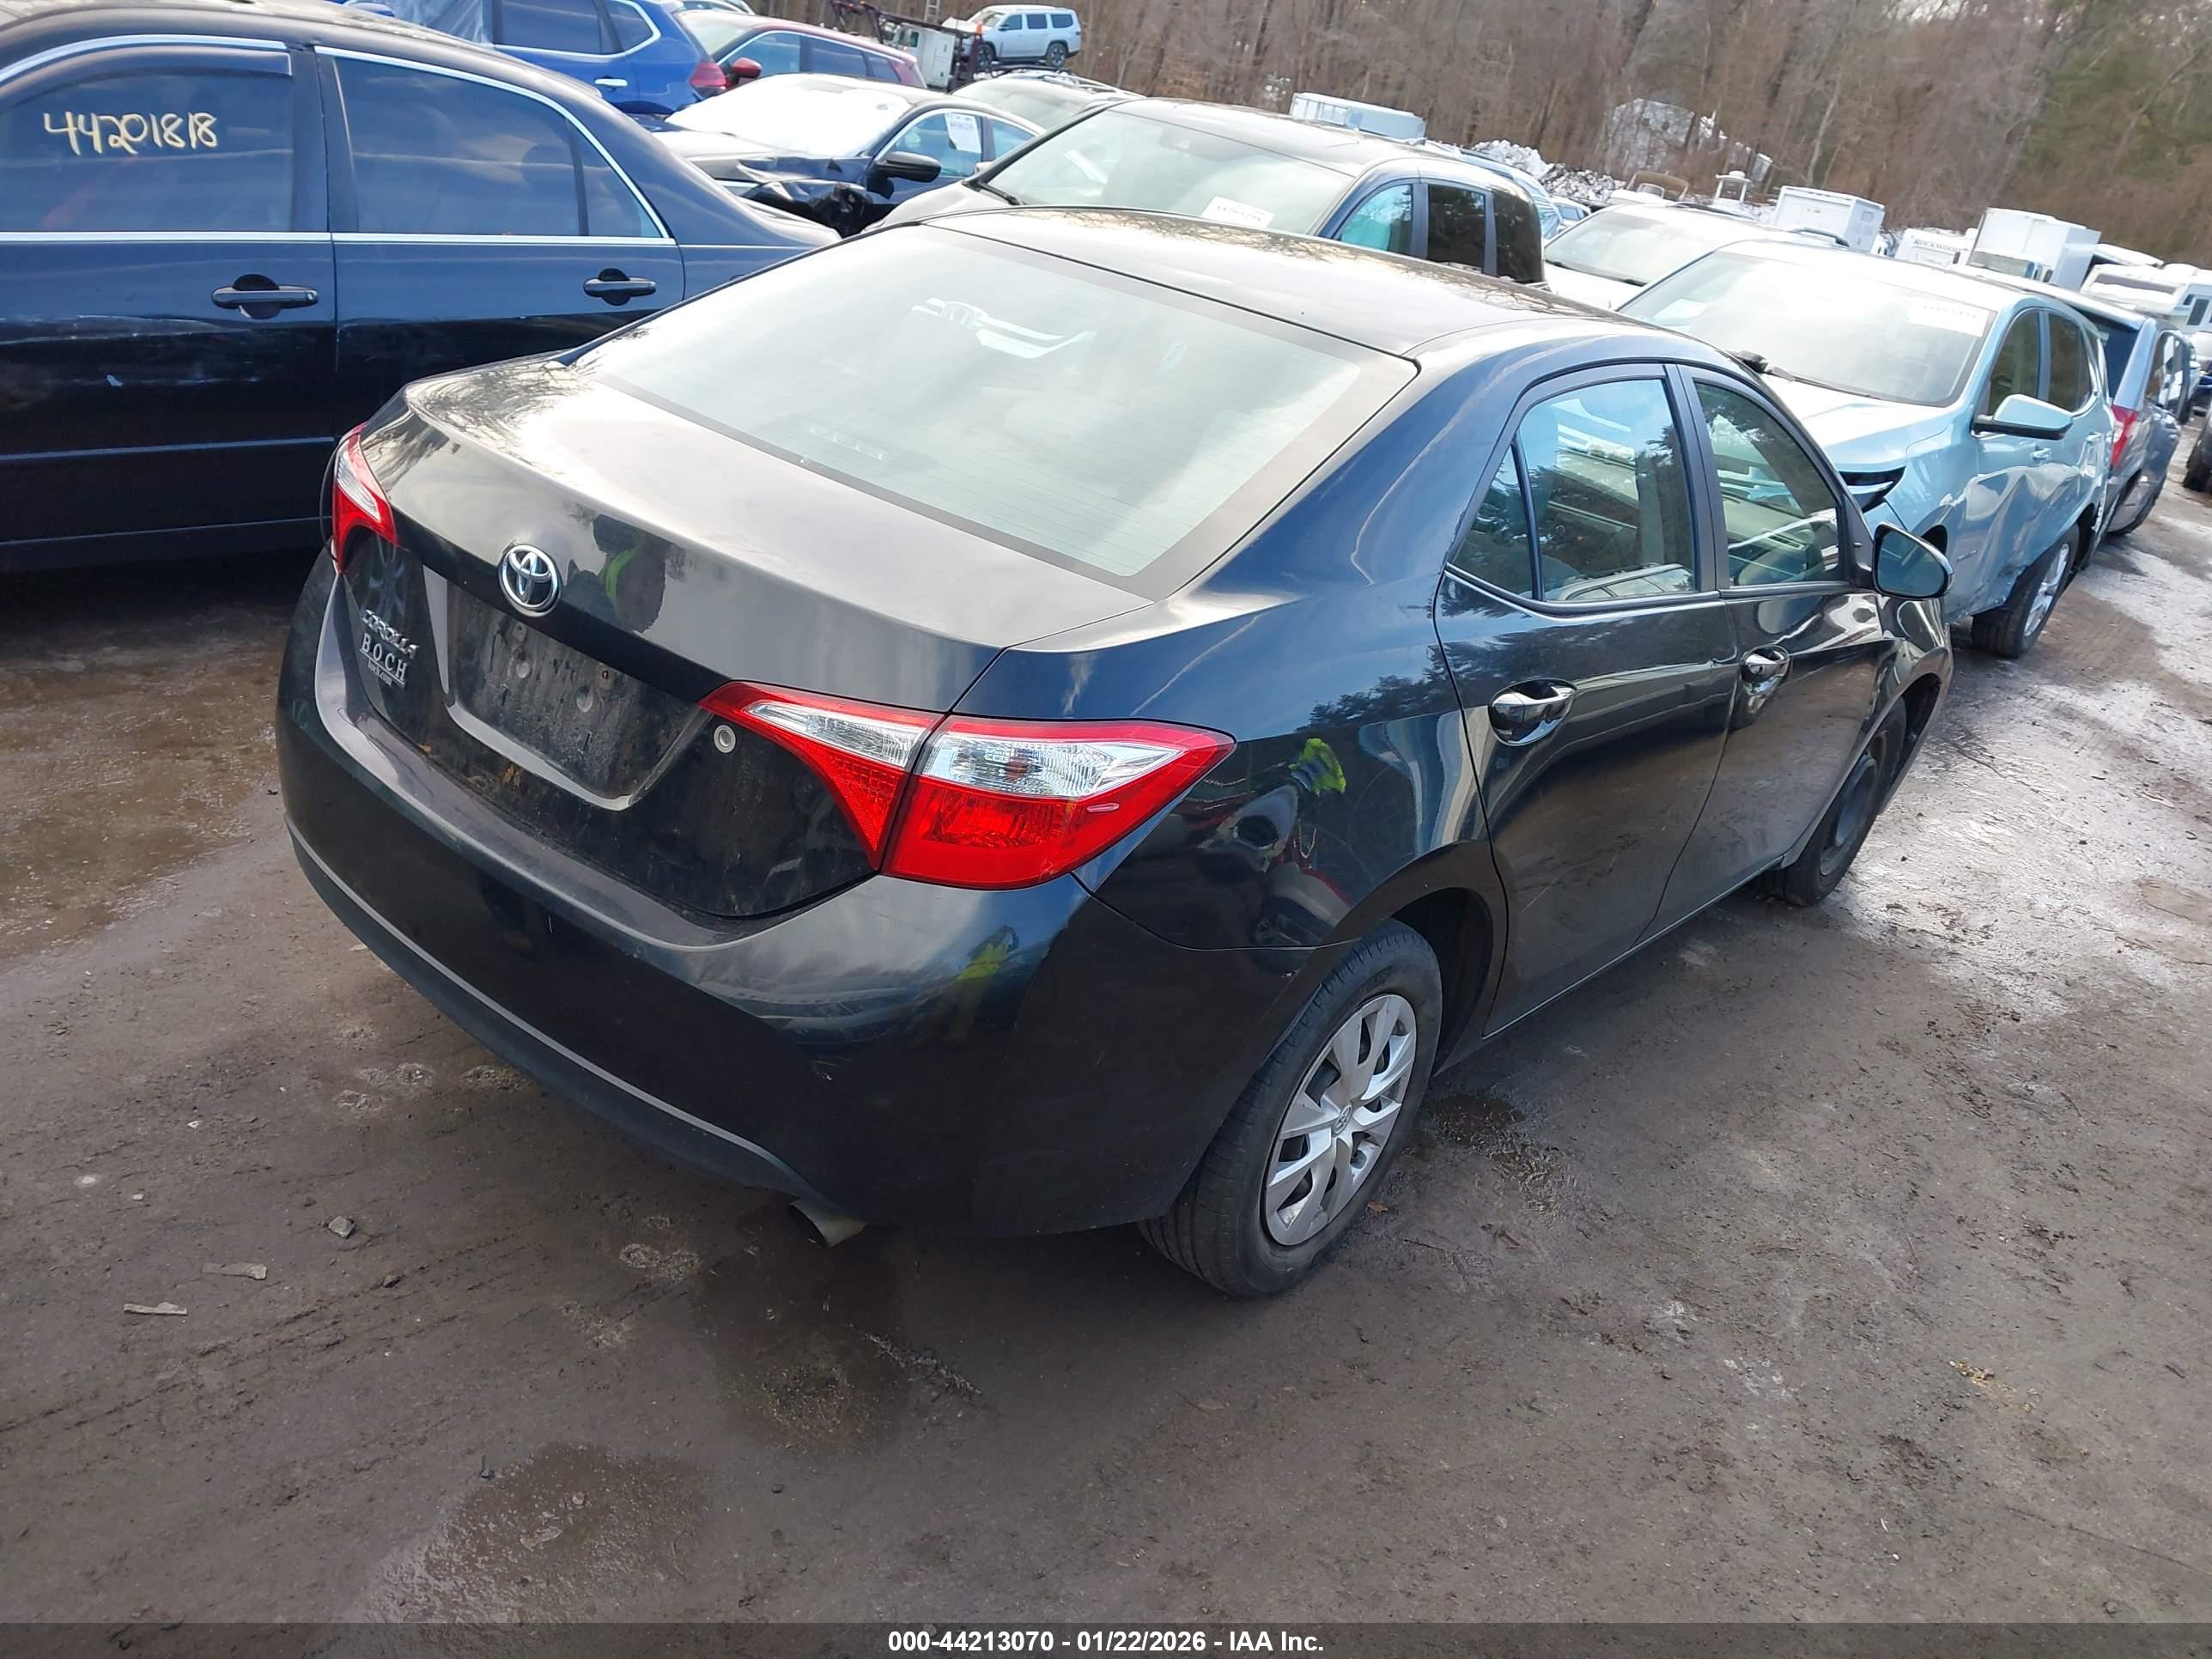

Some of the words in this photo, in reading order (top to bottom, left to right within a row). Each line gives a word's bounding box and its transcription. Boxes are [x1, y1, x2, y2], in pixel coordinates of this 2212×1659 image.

[43, 111, 218, 155] 44201818
[362, 609, 419, 659] COROLLA
[362, 632, 408, 682] BOCH
